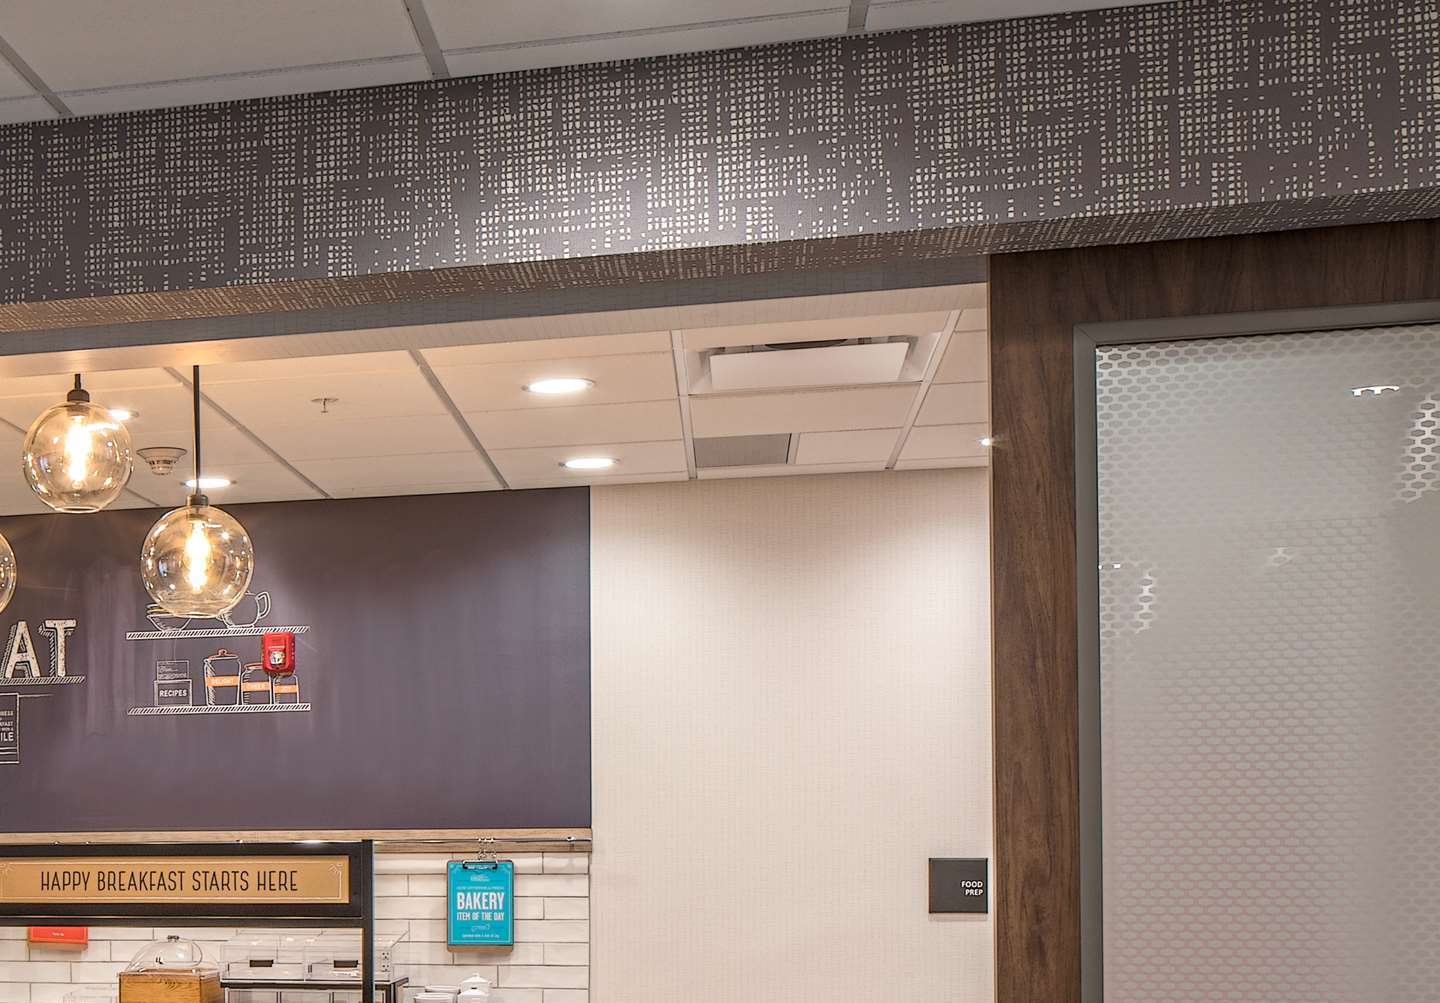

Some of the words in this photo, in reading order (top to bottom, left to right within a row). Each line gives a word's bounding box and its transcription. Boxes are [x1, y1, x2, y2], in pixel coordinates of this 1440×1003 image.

[159, 689, 188, 697] RECIPES
[40, 870, 90, 891] HAPPY
[97, 870, 186, 891] BREAKFAST
[192, 870, 249, 891] STARTS
[257, 870, 299, 891] HERE
[961, 880, 984, 888] FOOD
[456, 892, 505, 910] BAKERY
[456, 911, 471, 921] ITEM
[472, 911, 480, 921] OF
[482, 911, 492, 921] THE
[493, 911, 505, 921] DAY
